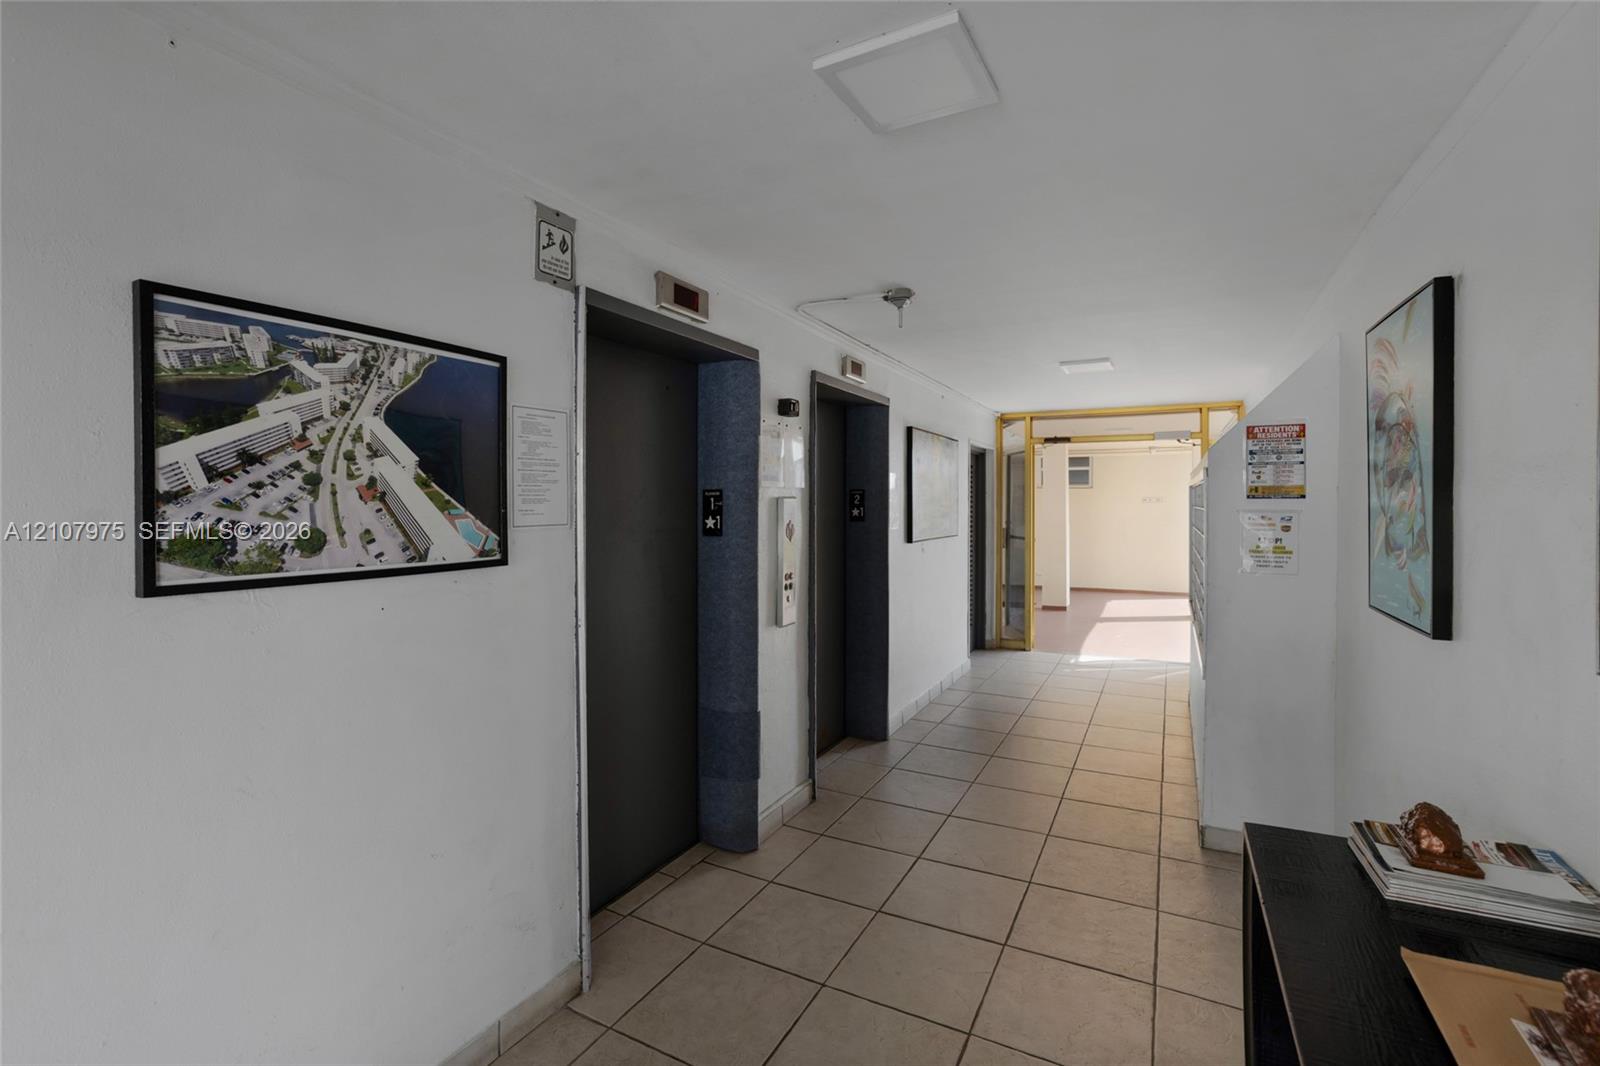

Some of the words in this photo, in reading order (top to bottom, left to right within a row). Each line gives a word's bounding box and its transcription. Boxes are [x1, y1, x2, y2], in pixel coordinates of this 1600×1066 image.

[1253, 425, 1300, 433] ATTENTION
[710, 497, 714, 510] 1
[854, 494, 860, 505] 2
[715, 515, 720, 529] 1
